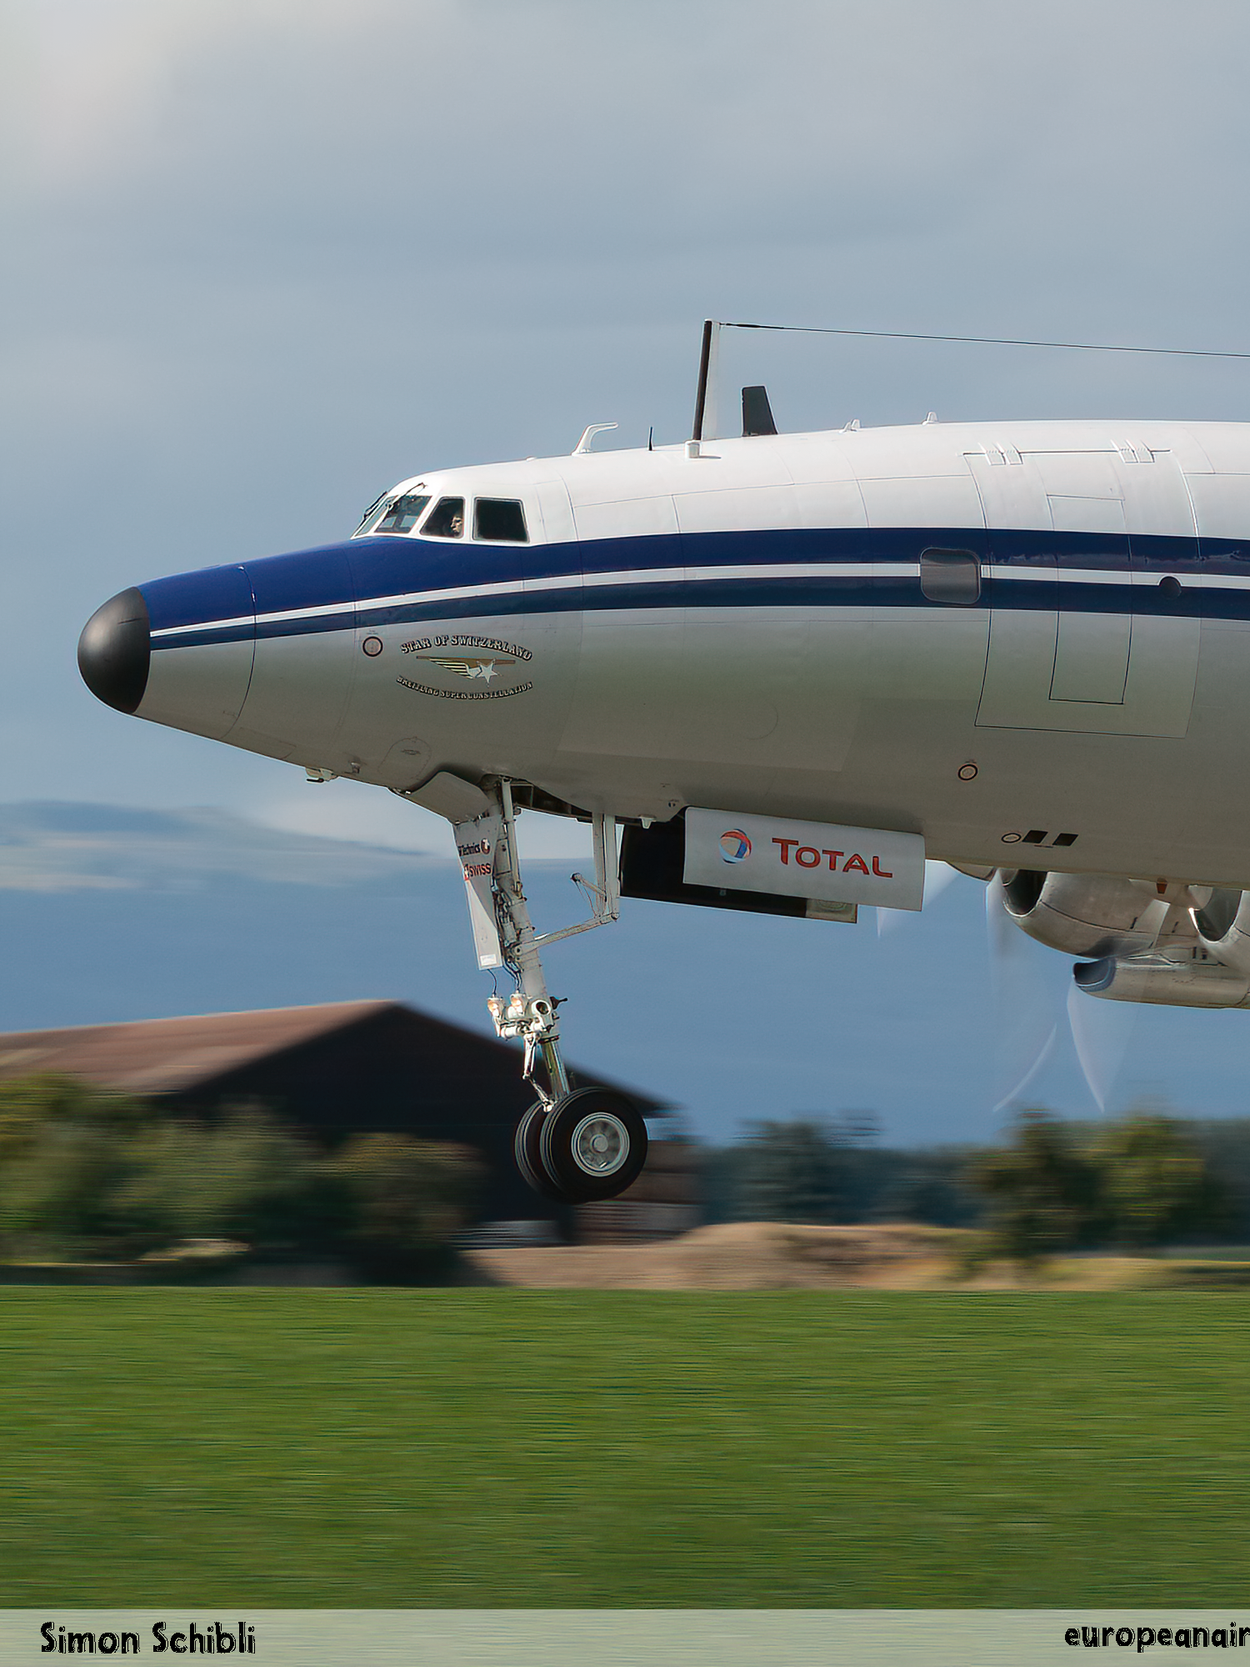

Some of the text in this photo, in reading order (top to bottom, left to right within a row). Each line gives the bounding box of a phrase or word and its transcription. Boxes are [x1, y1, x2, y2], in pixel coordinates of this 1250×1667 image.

[401, 635, 533, 661] STAR OF SWITZERLAND
